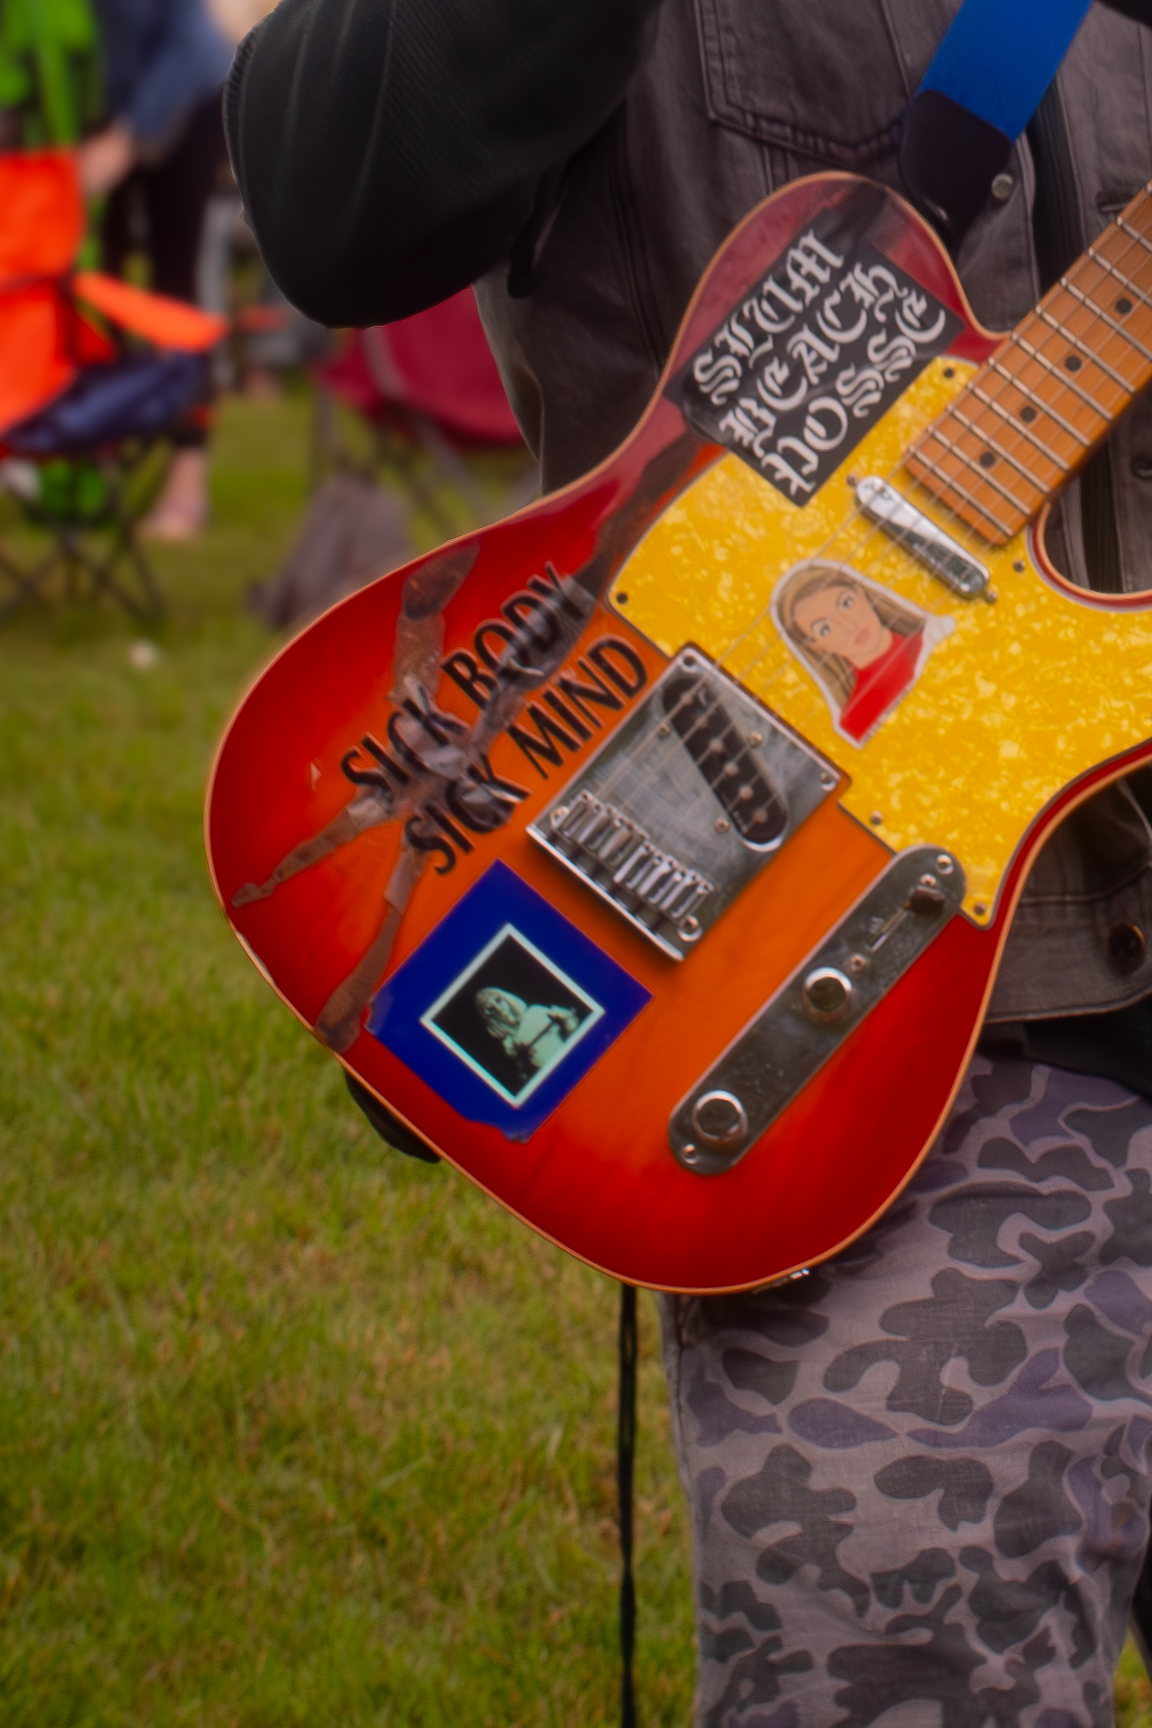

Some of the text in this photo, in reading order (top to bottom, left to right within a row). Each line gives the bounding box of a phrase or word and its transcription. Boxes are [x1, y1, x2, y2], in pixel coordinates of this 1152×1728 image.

[693, 228, 844, 406] SLUM
[718, 261, 908, 459] BEACH
[761, 288, 946, 496] POSSE
[340, 560, 587, 796] SICK BODY
[404, 634, 649, 876] SICK MIND
